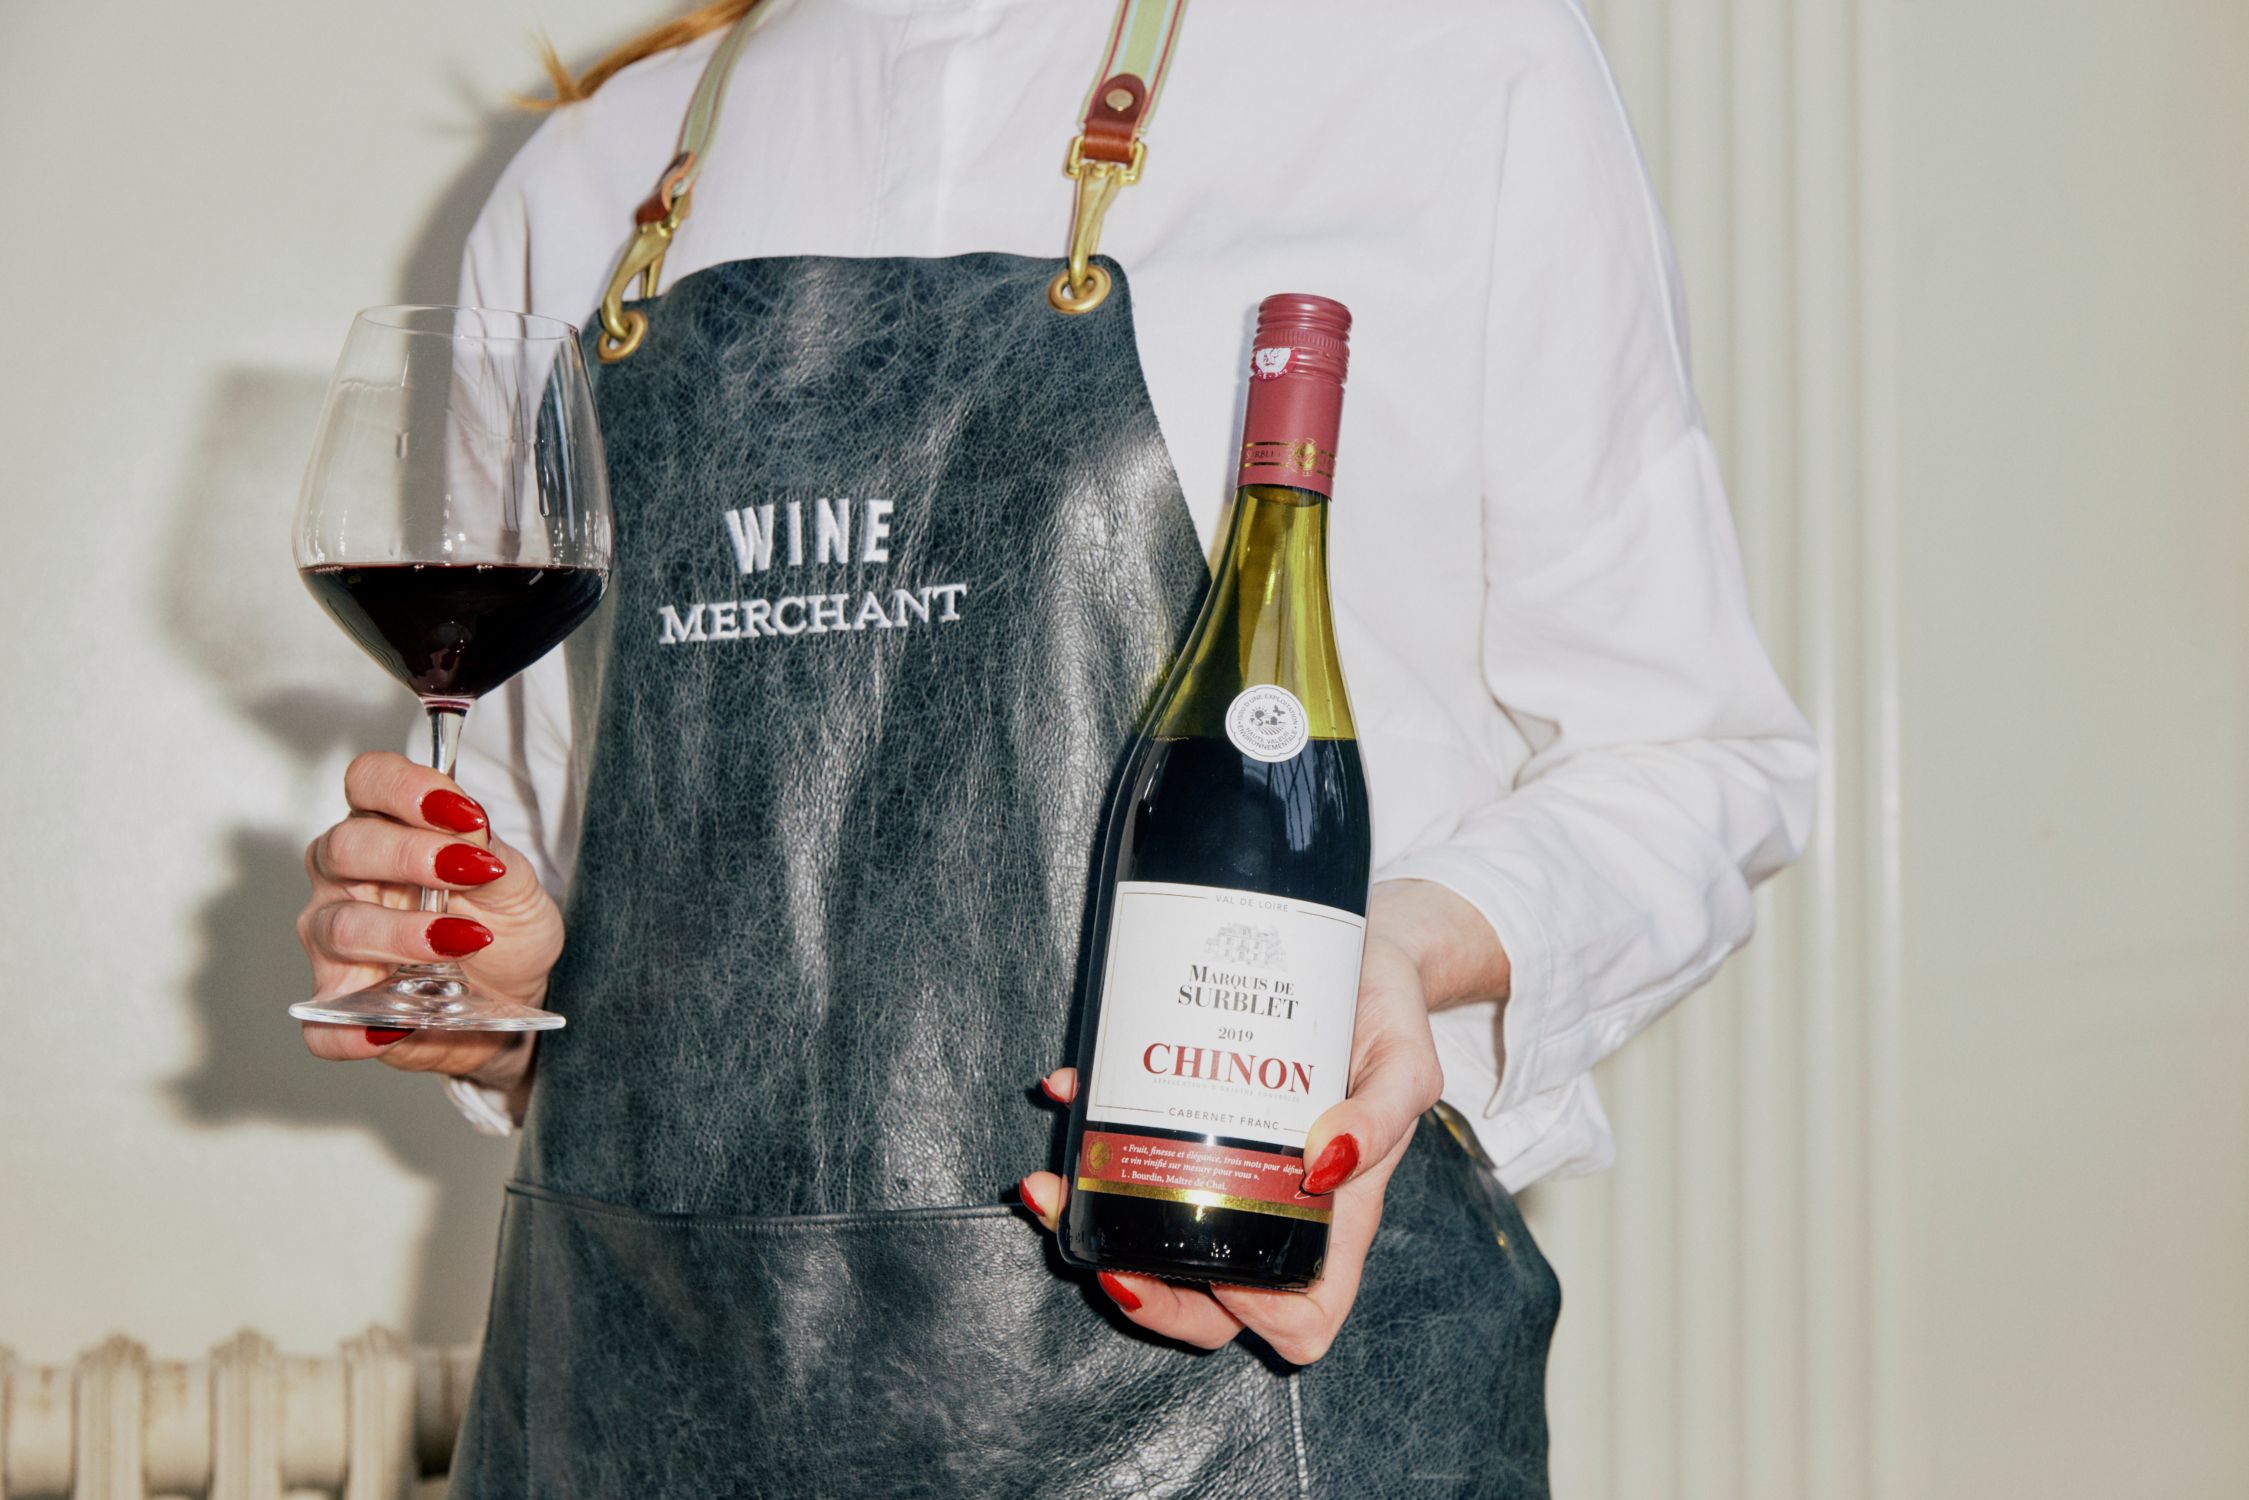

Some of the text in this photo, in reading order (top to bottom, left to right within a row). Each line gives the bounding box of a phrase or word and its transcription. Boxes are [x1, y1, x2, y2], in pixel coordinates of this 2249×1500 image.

[725, 498, 894, 575] WINE
[659, 583, 968, 645] MERCHANT
[1216, 895, 1289, 913] VAL DE LOIRE
[1274, 980, 1295, 996] DE
[1178, 984, 1299, 1020] SURBLET
[1218, 1027, 1254, 1042] 2019
[1143, 1043, 1315, 1095] CHINON
[1168, 1107, 1279, 1131] CABERNET FRANC
[1128, 1144, 1149, 1155] Fruit,
[1149, 1146, 1176, 1157] finesse
[1176, 1151, 1185, 1159] et
[1224, 1157, 1242, 1167] trois
[1243, 1160, 1262, 1169] mots
[1262, 1162, 1281, 1172] pour
[1130, 1156, 1142, 1165] vin
[1143, 1158, 1168, 1170] vinifié
[1168, 1162, 1181, 1170] sur
[1183, 1164, 1212, 1173] mesure
[1212, 1168, 1233, 1177] pour
[1234, 1170, 1252, 1179] vous
[1132, 1171, 1165, 1183] Bourdin,
[1193, 1178, 1204, 1187] de
